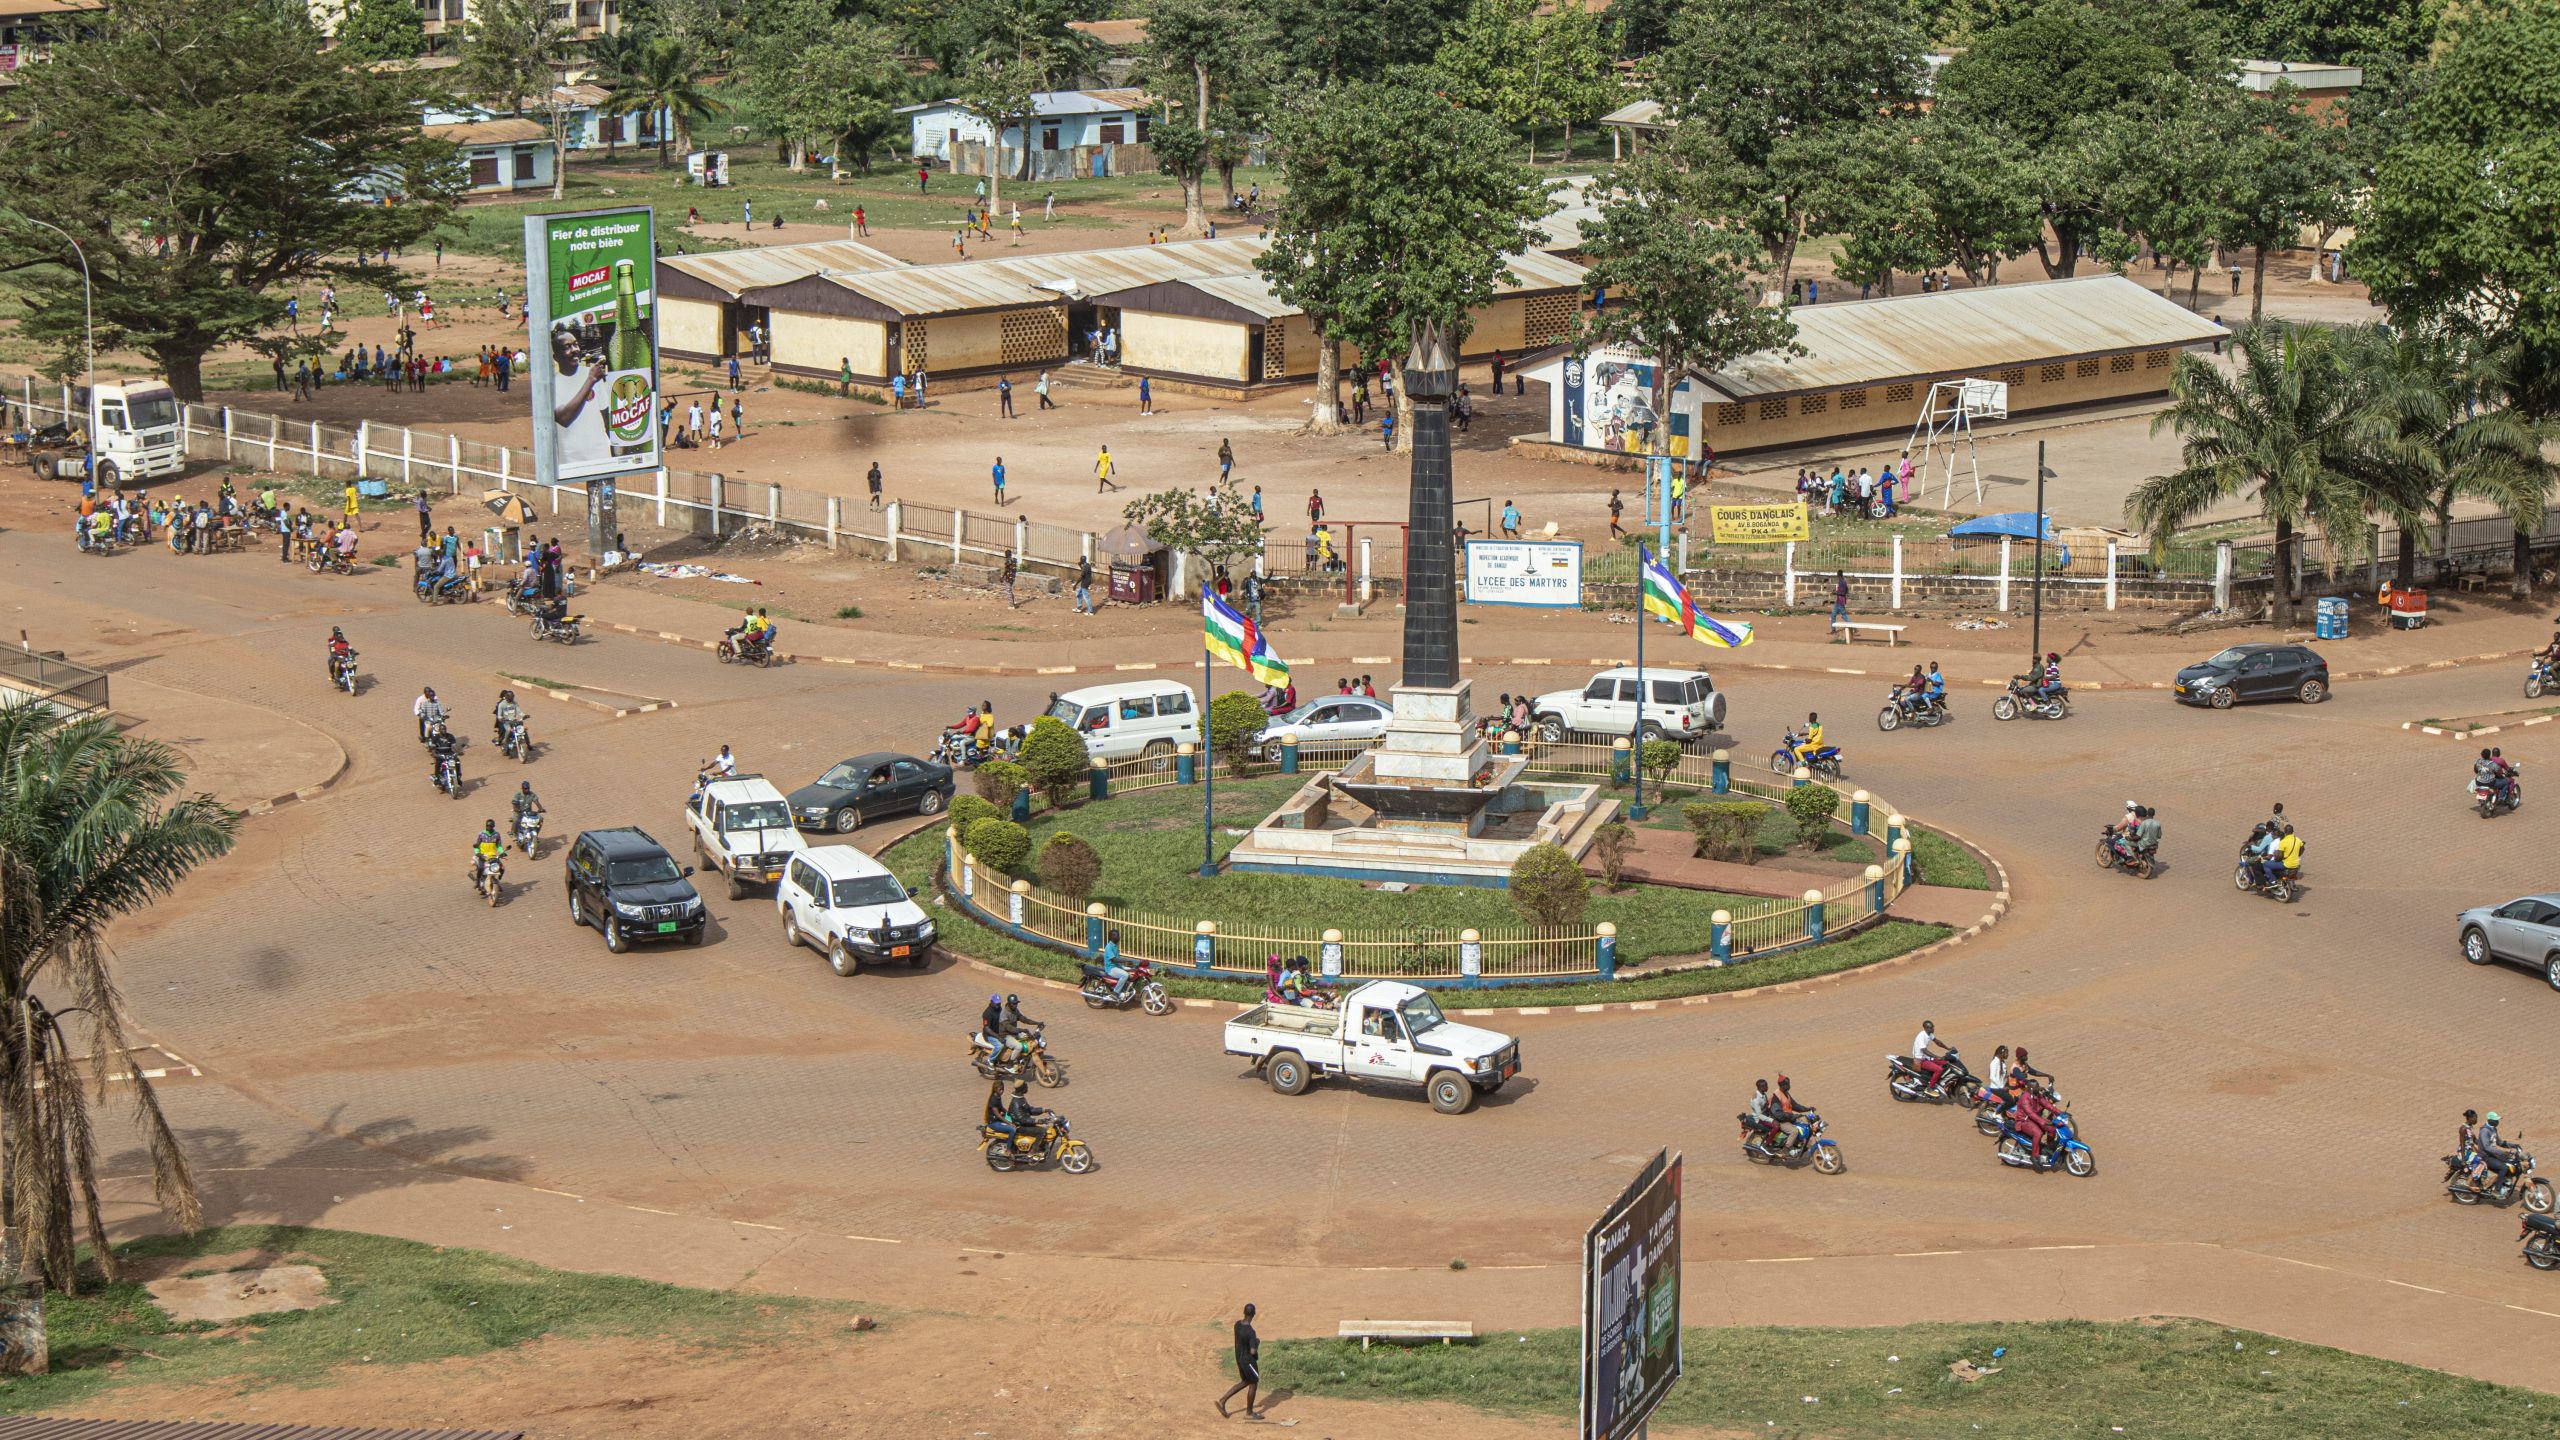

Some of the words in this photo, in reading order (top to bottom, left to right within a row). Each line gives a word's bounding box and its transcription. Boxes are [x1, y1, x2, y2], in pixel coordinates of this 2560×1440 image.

[552, 230, 573, 241] Fier
[575, 228, 588, 238] de
[590, 223, 640, 237] distribuer
[570, 241, 597, 251] notre
[598, 238, 624, 248] bière
[573, 270, 606, 288] MOCAF
[612, 396, 650, 425] MOCAF
[1717, 511, 1747, 520] COURS
[1750, 509, 1794, 520] D'ANGLAIS
[1477, 576, 1506, 587] LYCEE
[1510, 577, 1525, 587] DES
[1529, 578, 1567, 588] MARTYRS
